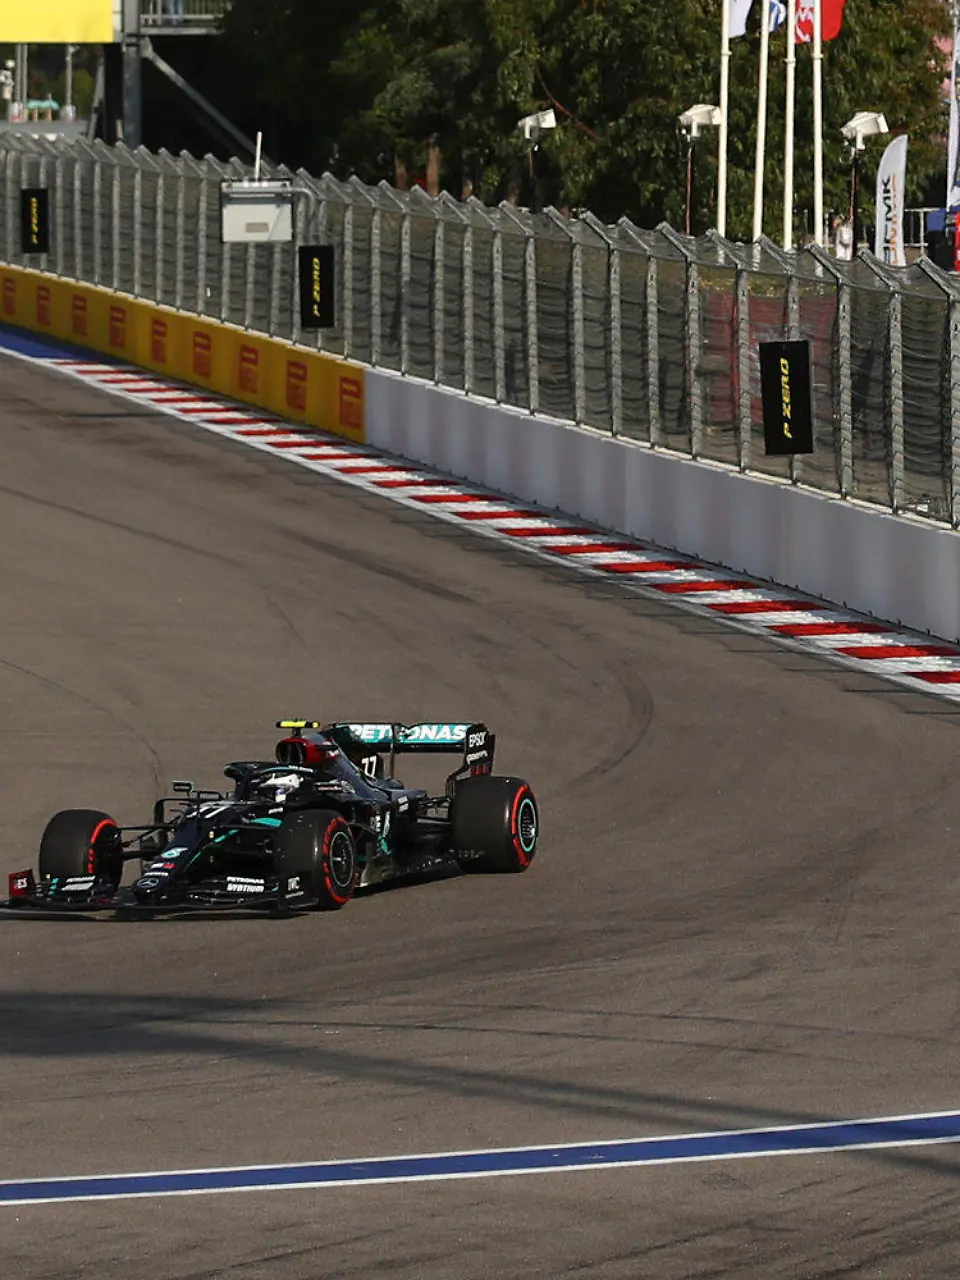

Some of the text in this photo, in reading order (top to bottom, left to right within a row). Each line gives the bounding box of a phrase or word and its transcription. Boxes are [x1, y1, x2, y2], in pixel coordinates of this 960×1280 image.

[780, 357, 793, 439] P ZERO
[469, 731, 487, 748] EPSO
